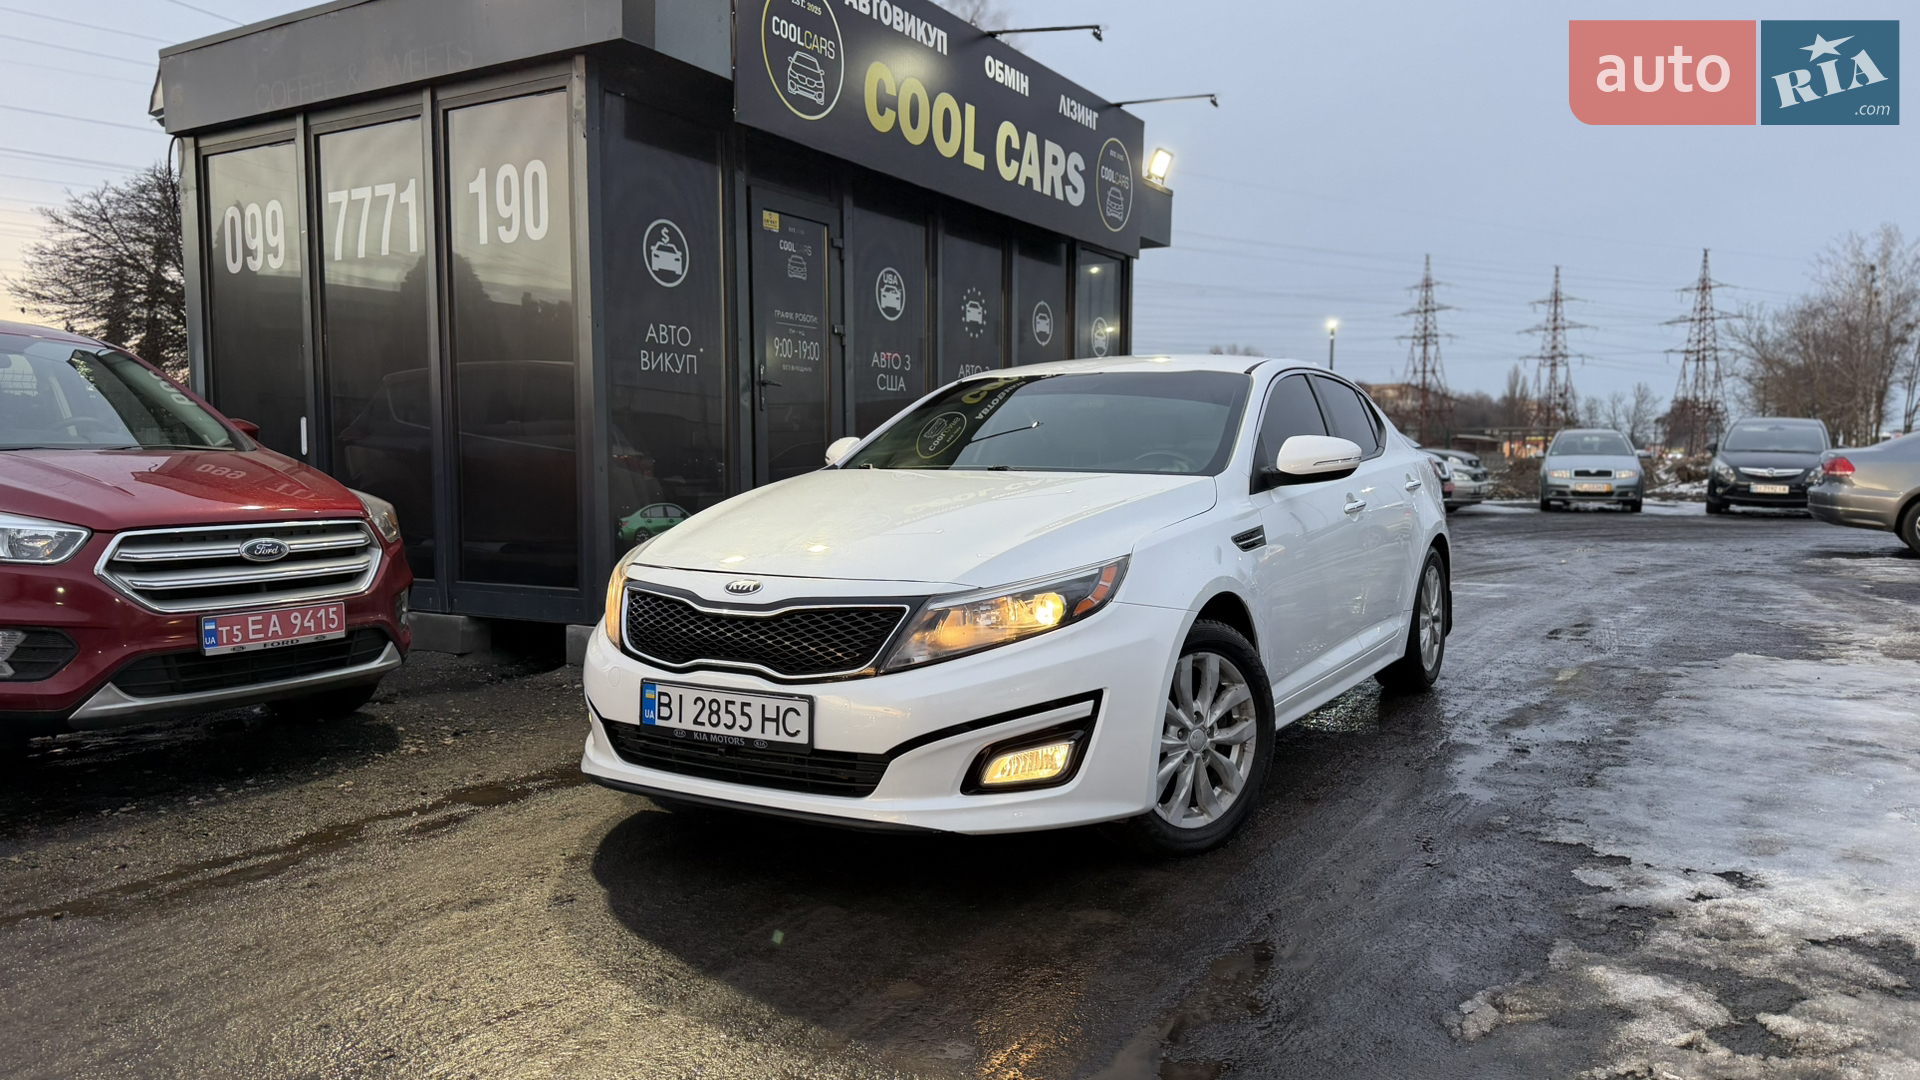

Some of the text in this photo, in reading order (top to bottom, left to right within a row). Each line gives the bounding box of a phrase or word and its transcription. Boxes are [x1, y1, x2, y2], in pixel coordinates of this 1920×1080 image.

[806, 2, 822, 16] 2025
[772, 15, 836, 60] COOLCARS
[985, 55, 1029, 97] ОБМІН
[1059, 94, 1099, 131] ЛІЗИНГ
[864, 61, 1086, 207] COOL CARS
[224, 159, 549, 274] 099 7771 190
[882, 273, 899, 285] USA
[645, 323, 691, 347] АВТО
[774, 337, 793, 358] 9:00
[640, 350, 698, 375] ВИКУП
[871, 351, 901, 370] АВТО
[876, 373, 906, 392] США
[254, 543, 279, 555] Ford
[728, 580, 760, 591] KIA
[218, 607, 339, 644] T5 EA 9415
[204, 636, 216, 645] UA
[263, 639, 300, 648] FORD
[644, 708, 655, 719] UA
[657, 691, 802, 738] BI 2855 HC
[693, 731, 746, 747] KIA MOTORS
